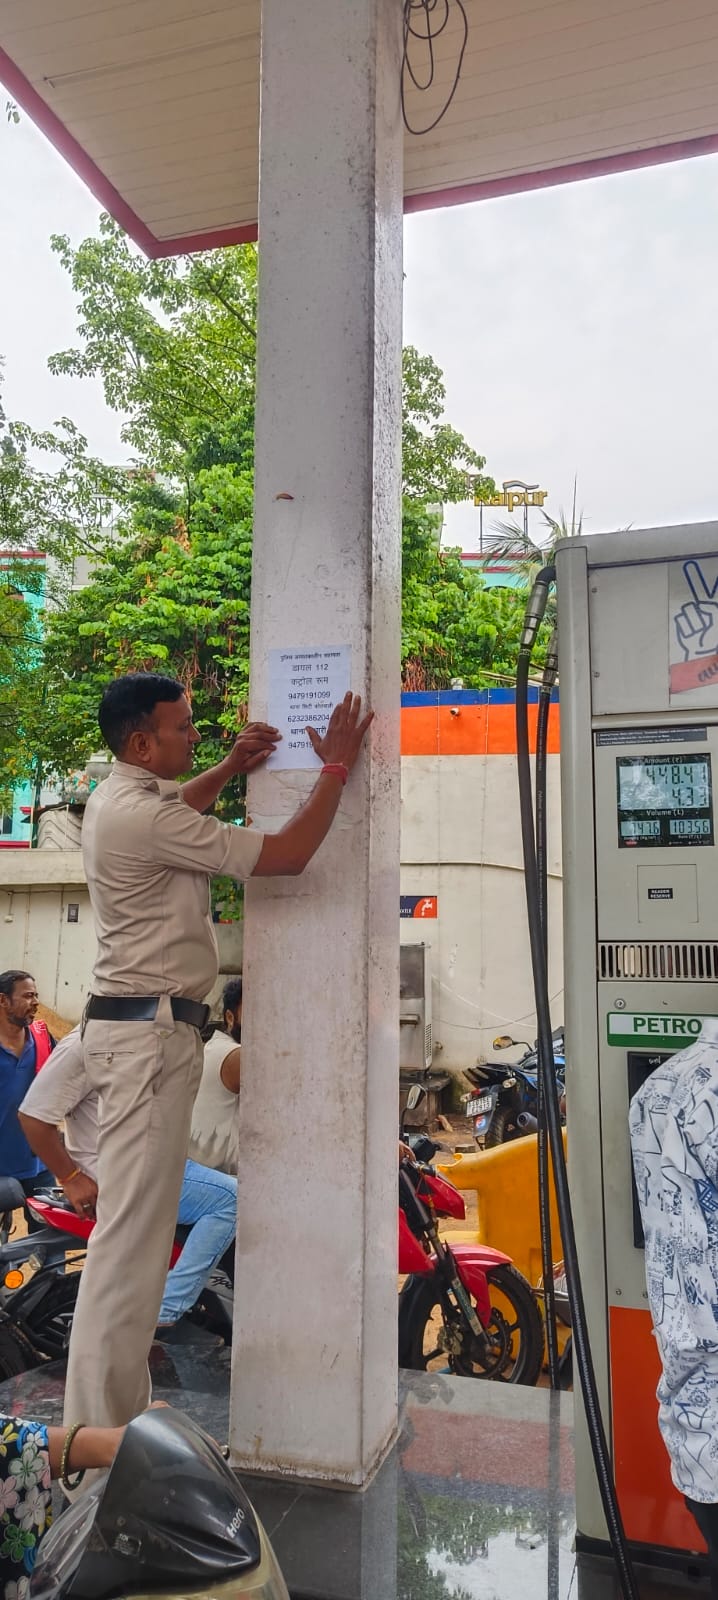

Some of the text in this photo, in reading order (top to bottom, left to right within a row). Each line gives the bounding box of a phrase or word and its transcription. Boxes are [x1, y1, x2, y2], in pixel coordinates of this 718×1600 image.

[316, 663, 329, 671] 112
[288, 691, 330, 699] 9479191099
[287, 714, 330, 722] 6232386204
[672, 787, 707, 807] 4.33
[673, 820, 709, 835] 103.56
[633, 1017, 702, 1034] PETRO
[225, 1508, 245, 1539] Hero
